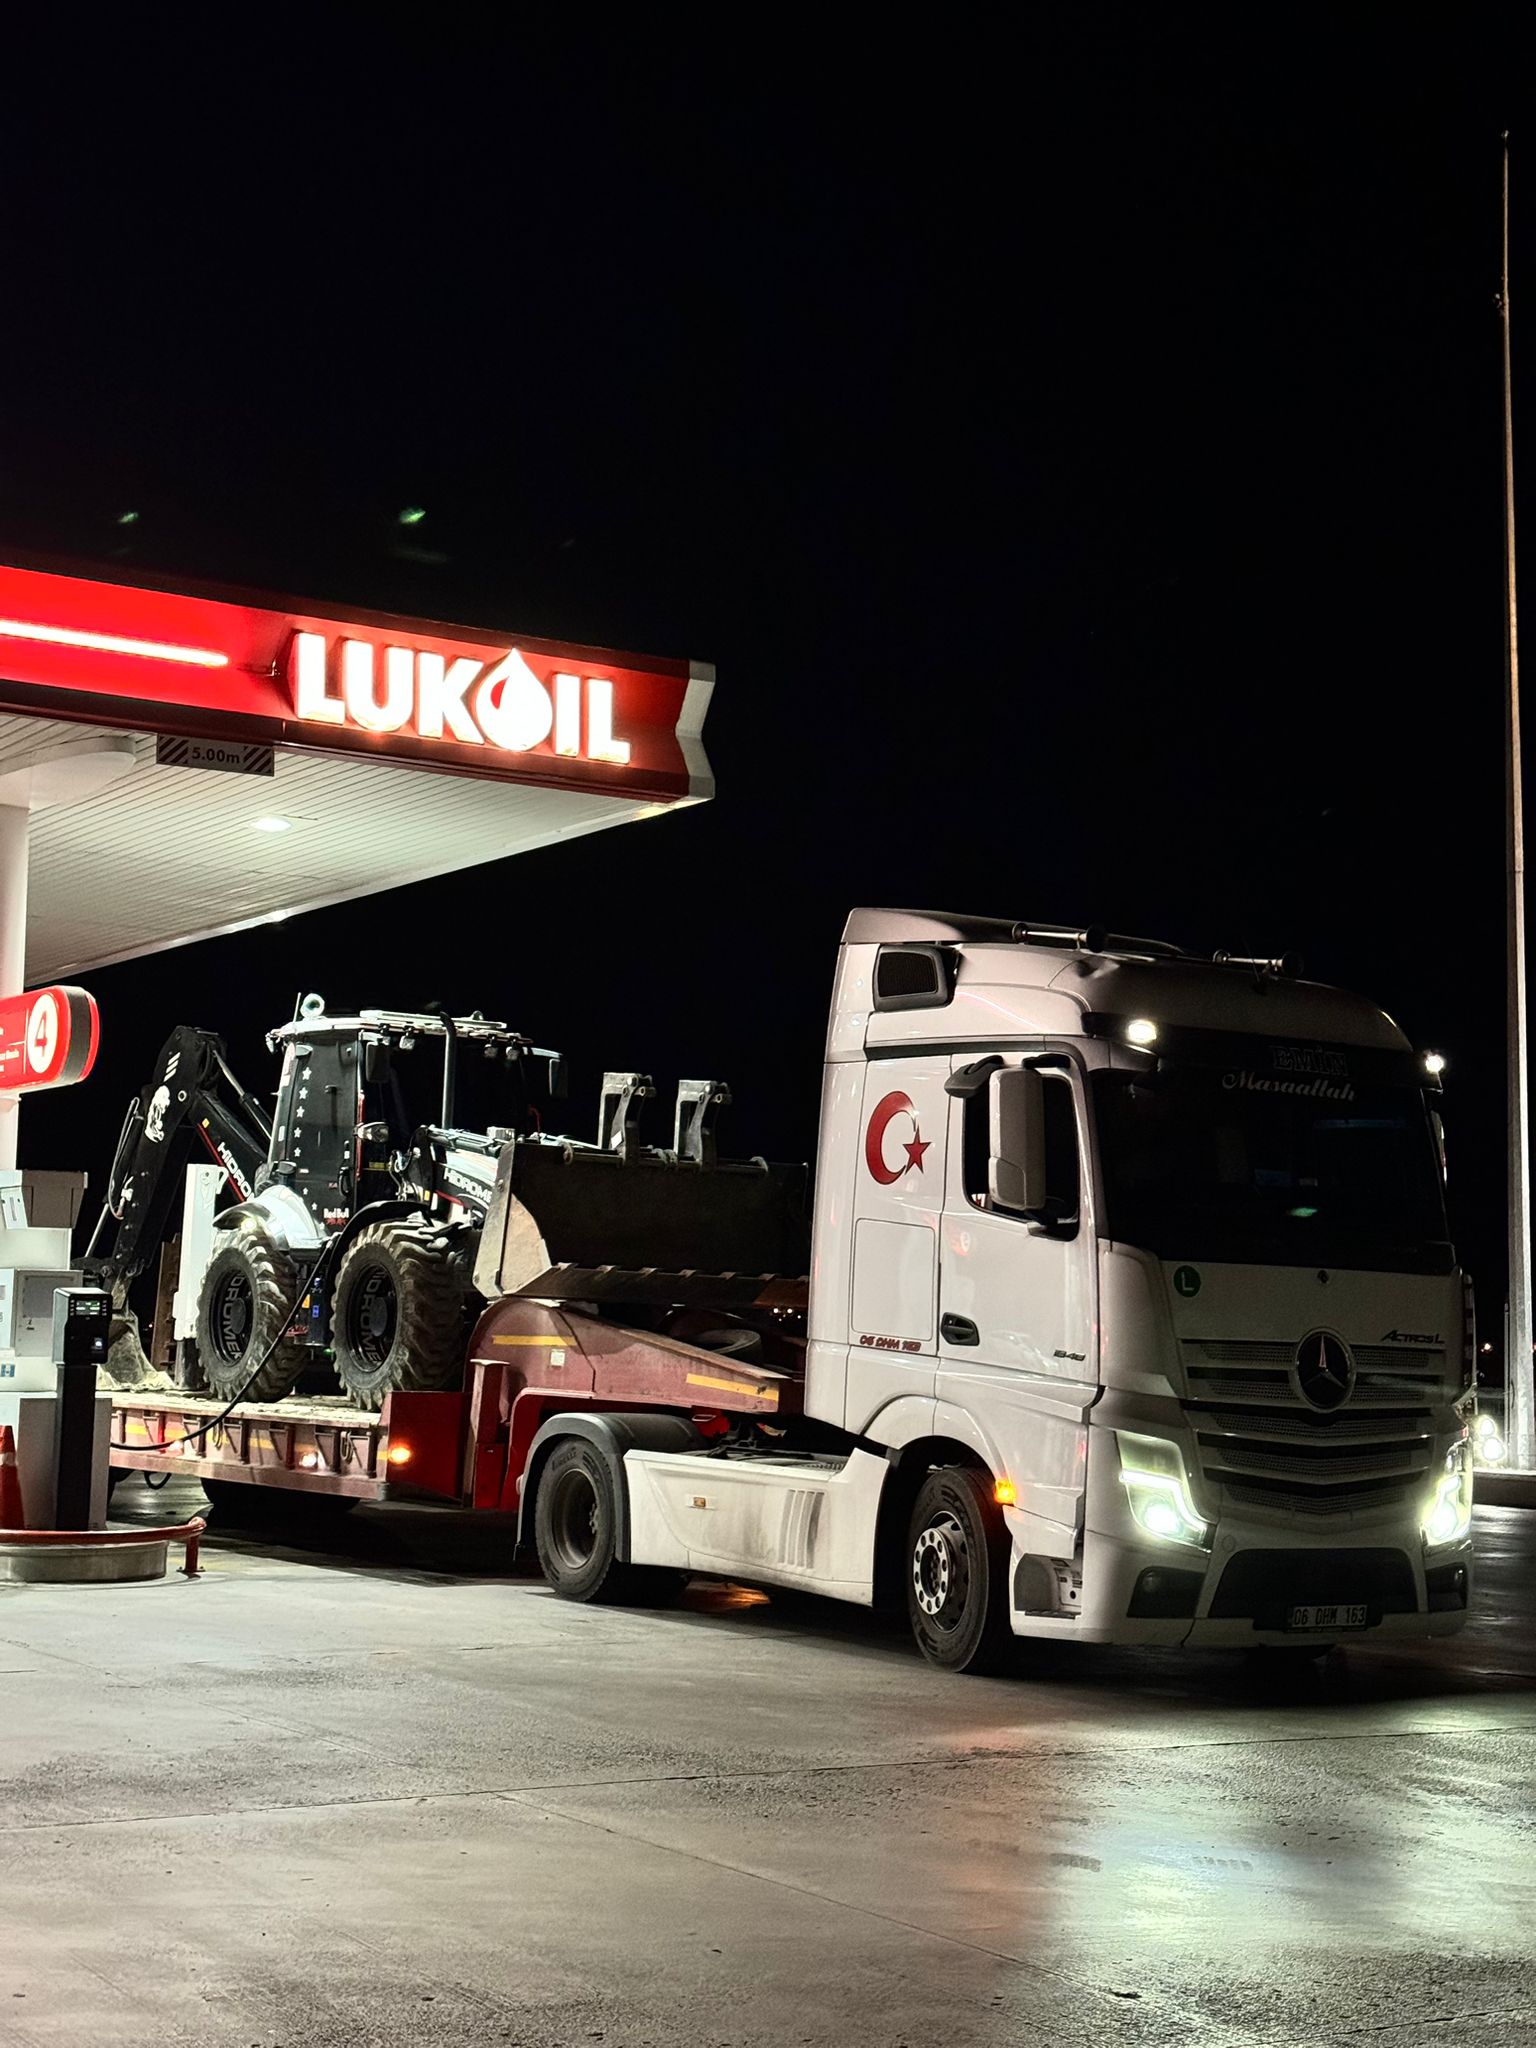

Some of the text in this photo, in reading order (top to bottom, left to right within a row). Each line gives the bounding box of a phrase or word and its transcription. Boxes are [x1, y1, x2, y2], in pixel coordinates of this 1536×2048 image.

[294, 632, 631, 765] LUKOIL
[191, 747, 241, 764] 5.00m
[34, 1010, 48, 1058] 4
[1181, 1271, 1195, 1291] L
